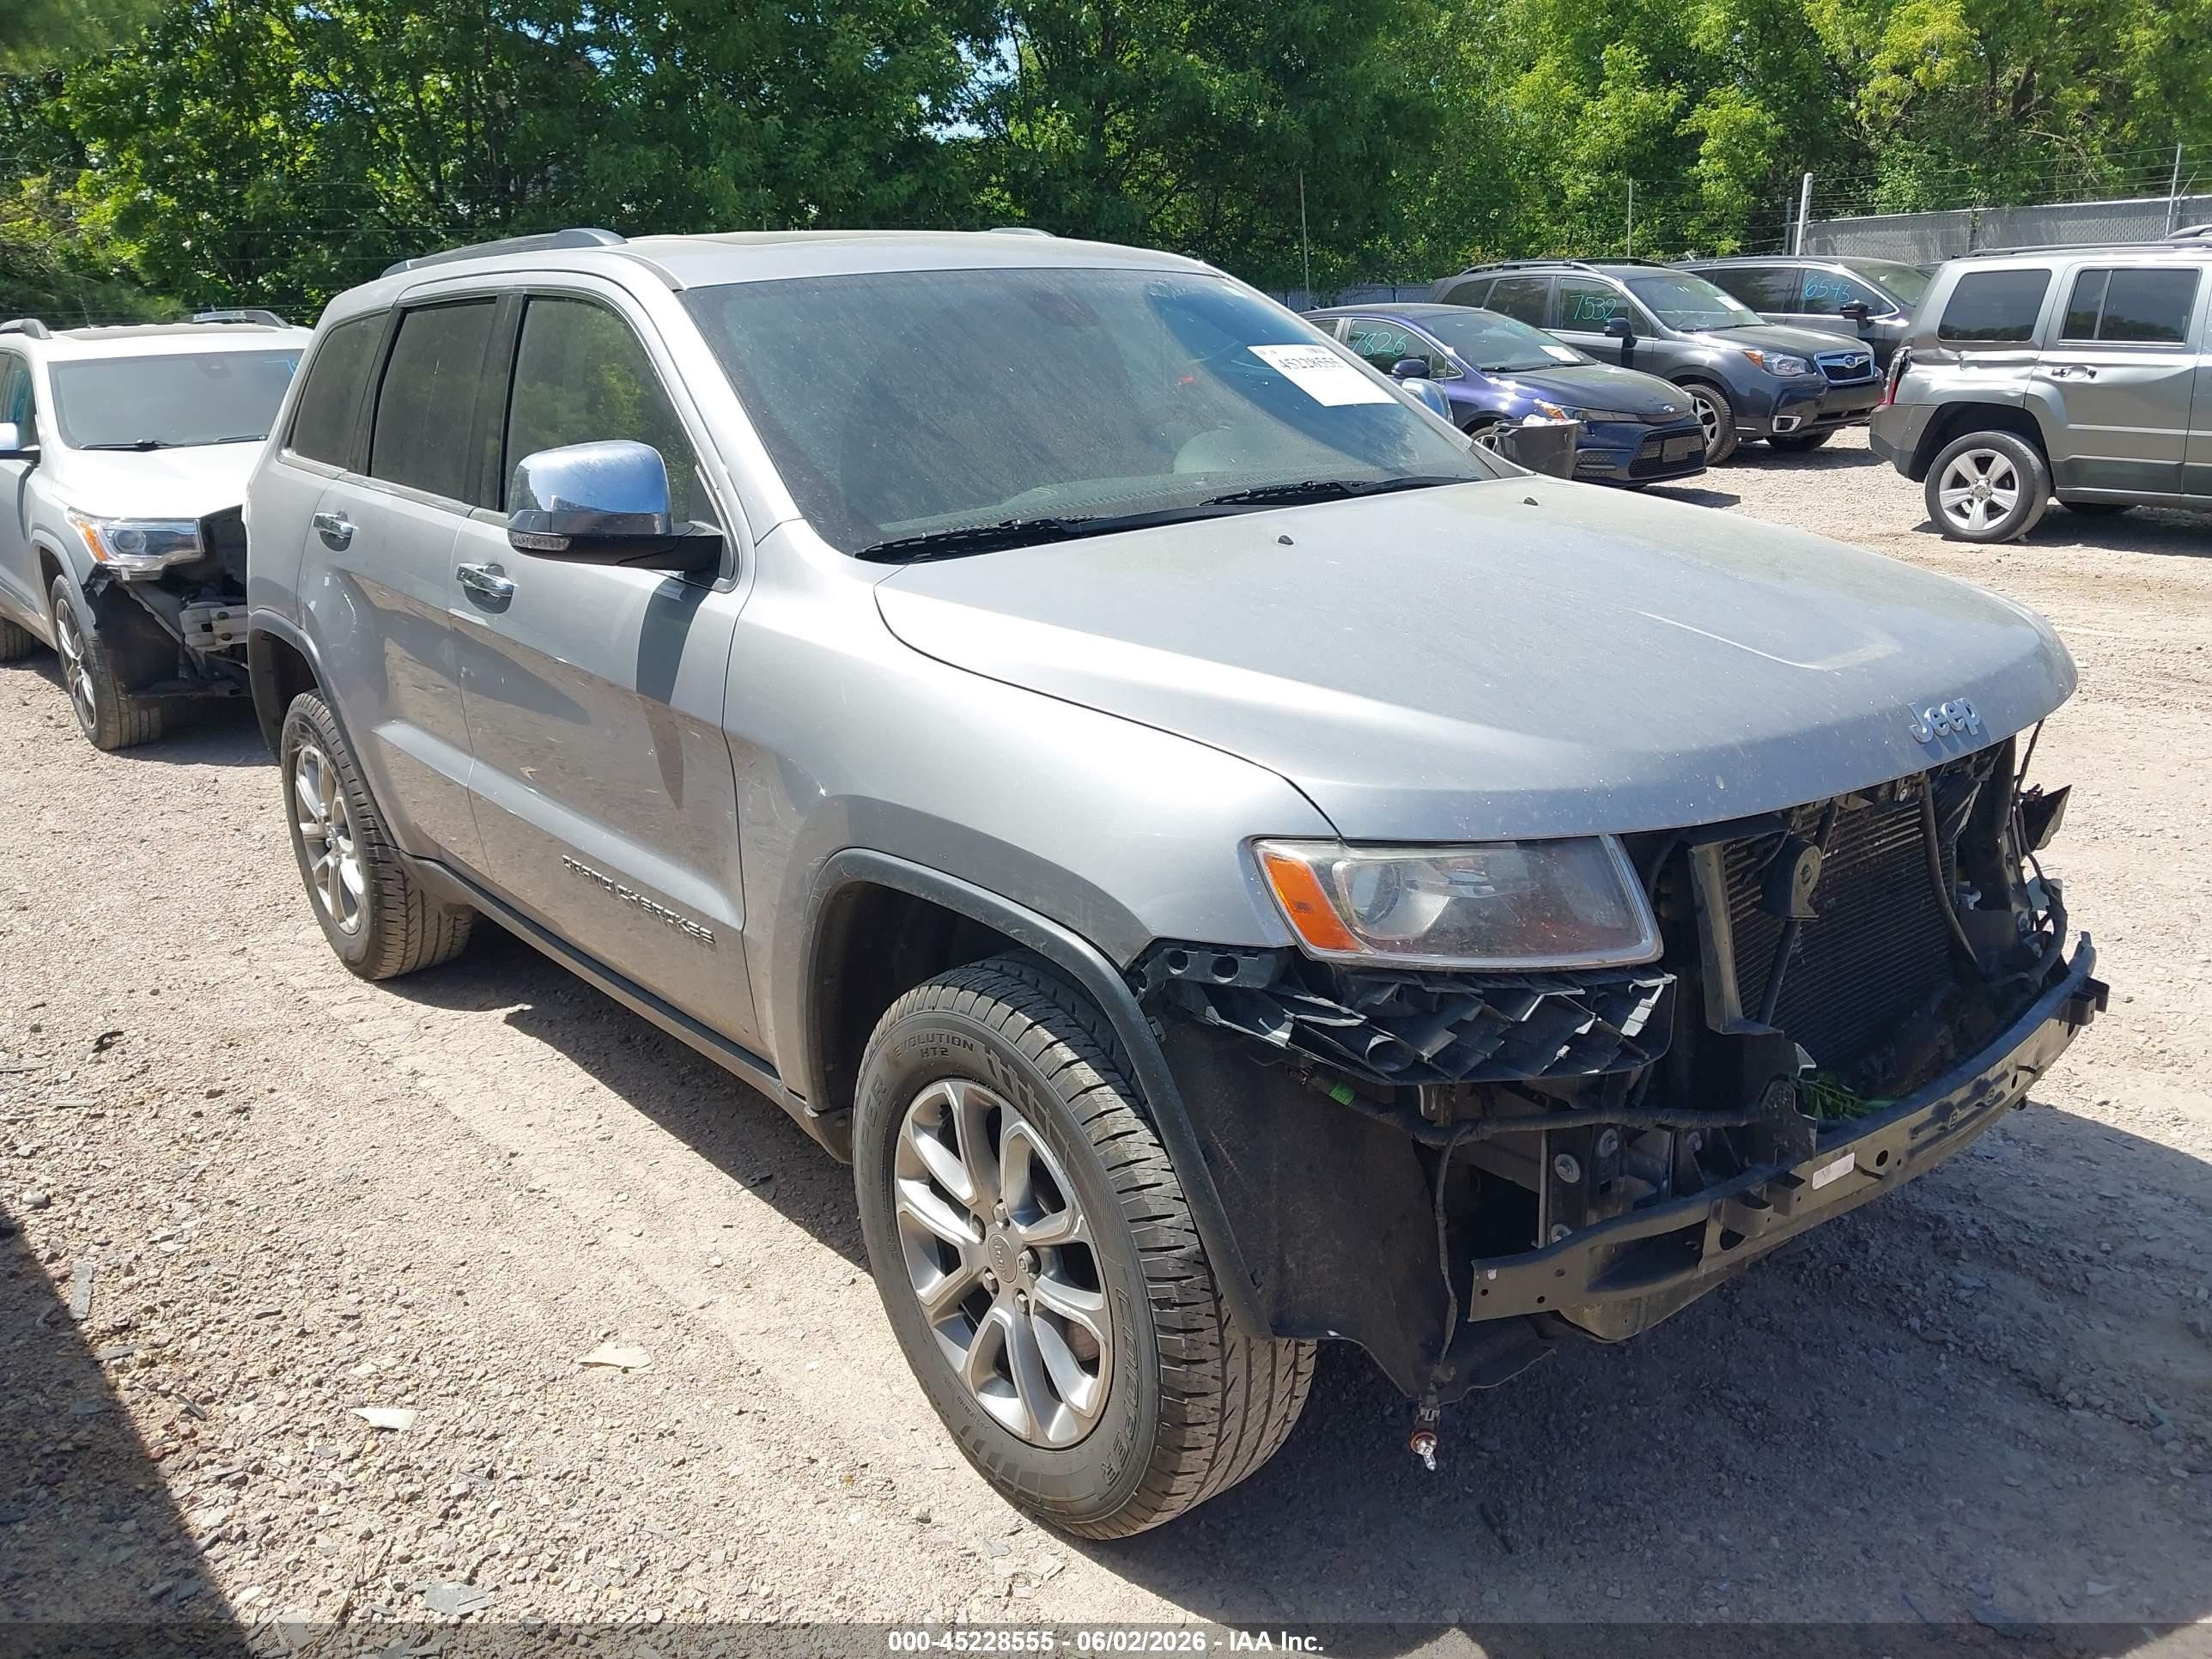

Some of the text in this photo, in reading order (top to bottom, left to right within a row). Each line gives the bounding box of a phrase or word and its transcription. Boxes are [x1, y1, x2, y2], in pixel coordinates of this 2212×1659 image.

[1805, 275, 1850, 302] 6543
[1568, 295, 1616, 320] 7532
[1351, 331, 1409, 356] 7826
[1908, 696, 1981, 744] Jeep
[892, 1032, 975, 1059] EVOLUTION
[920, 1046, 950, 1060] HT2
[1101, 1285, 1139, 1486] COOPER
